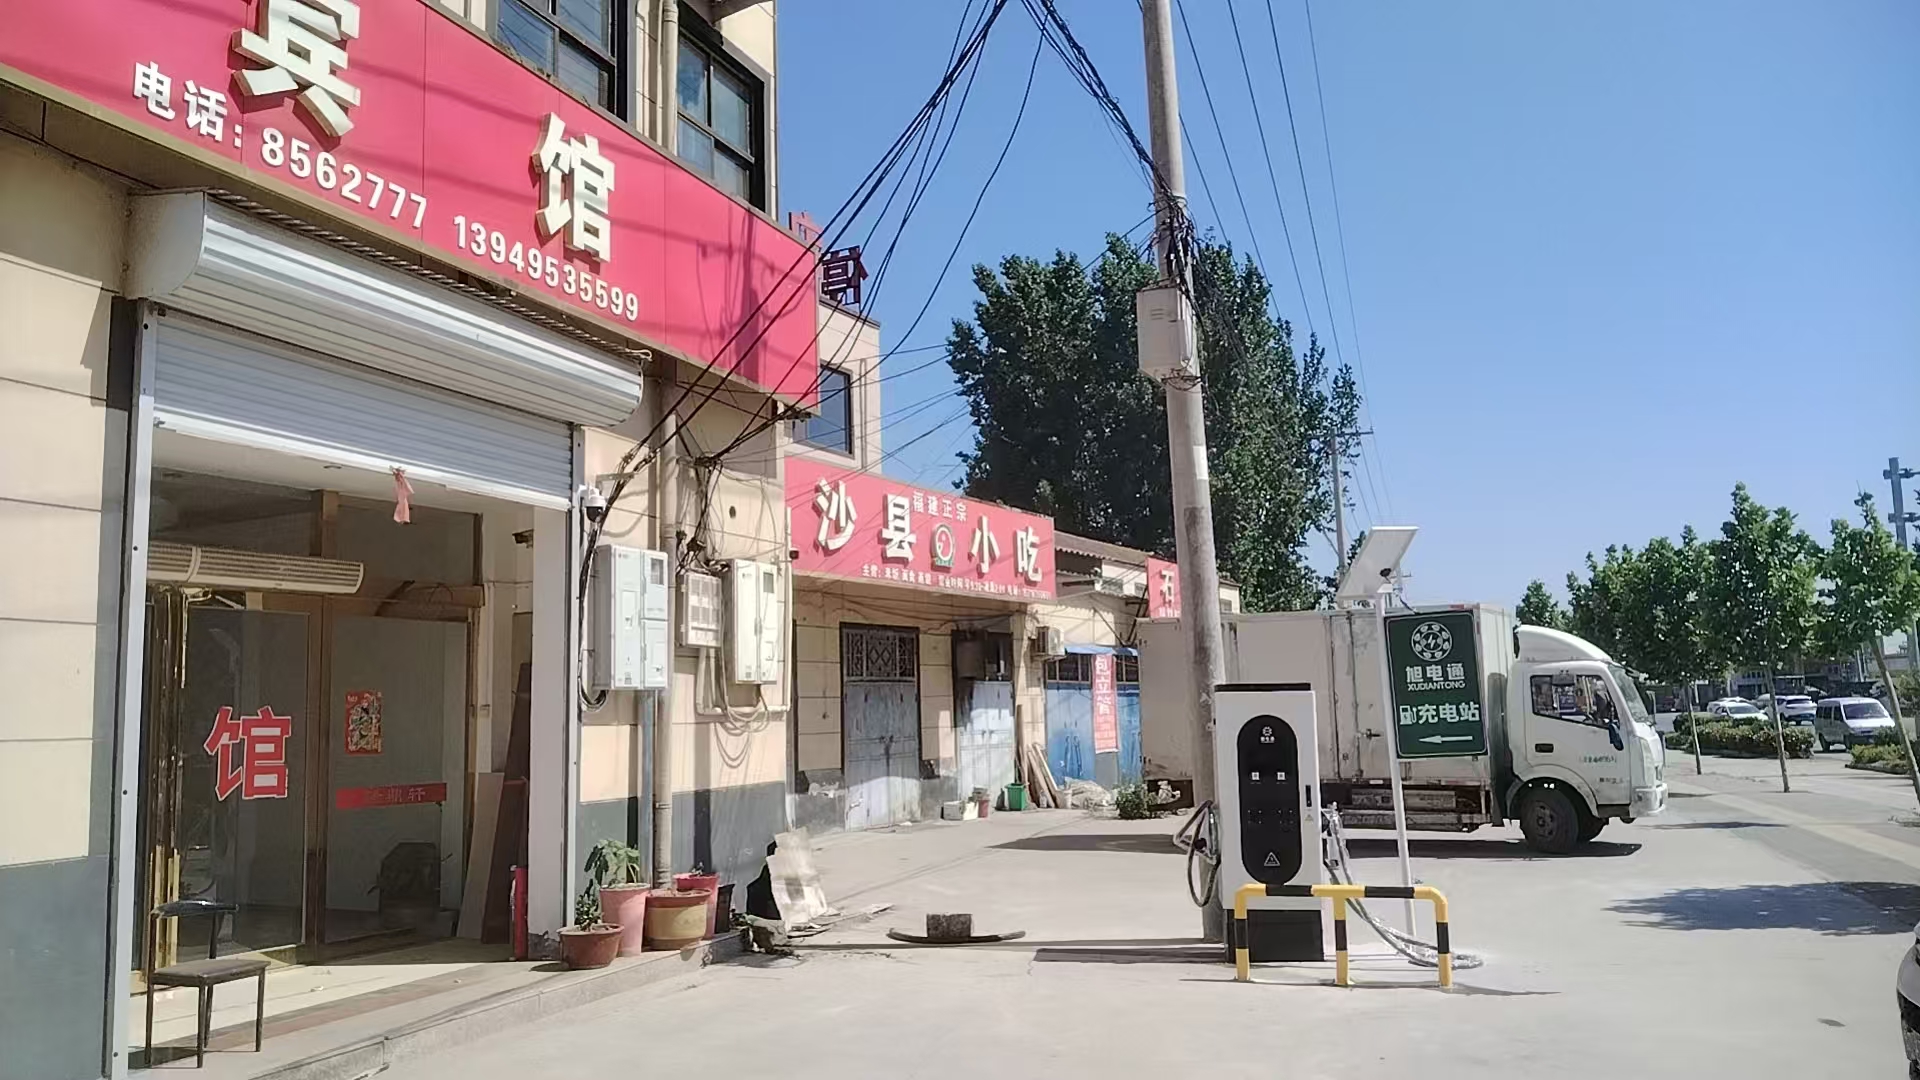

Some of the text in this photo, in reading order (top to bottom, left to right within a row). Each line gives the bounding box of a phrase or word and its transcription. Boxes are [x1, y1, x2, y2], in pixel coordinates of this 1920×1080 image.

[453, 215, 639, 322] 13949535599
[1405, 662, 1465, 684] 旭电通
[1407, 681, 1466, 691] XUDIANTONG
[1417, 702, 1480, 724] 充电站
[203, 704, 292, 802] 馆
